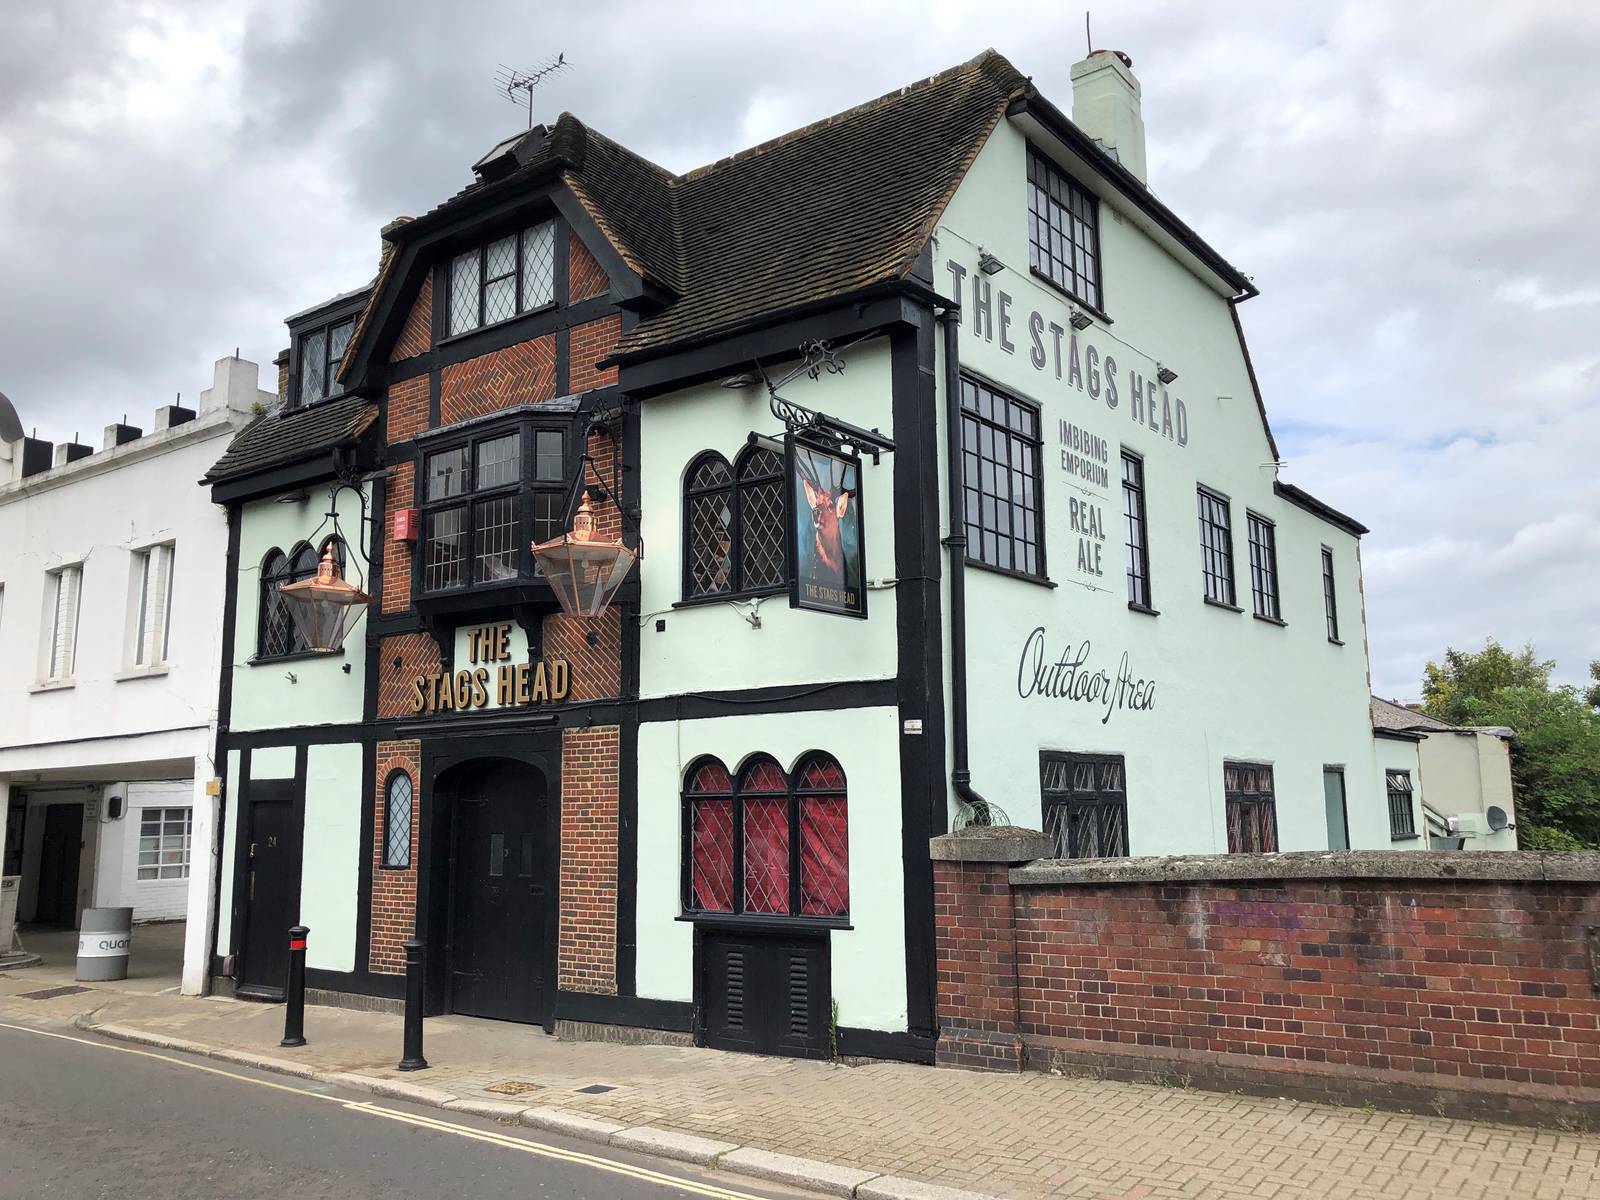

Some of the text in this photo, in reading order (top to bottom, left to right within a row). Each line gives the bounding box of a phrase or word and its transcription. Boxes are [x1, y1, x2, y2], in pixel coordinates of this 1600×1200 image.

[947, 259, 1188, 448] THE STAGS HEAD
[1059, 418, 1109, 464] IMBIBING
[1061, 450, 1109, 489] EMPORIUM
[1069, 496, 1106, 540] REAL
[1077, 538, 1103, 576] ALE
[805, 583, 855, 605] THE STAGS HEAD
[467, 624, 512, 663] THE
[411, 659, 571, 713] STAGS HEAD
[1017, 626, 1156, 724] Outdoor Area
